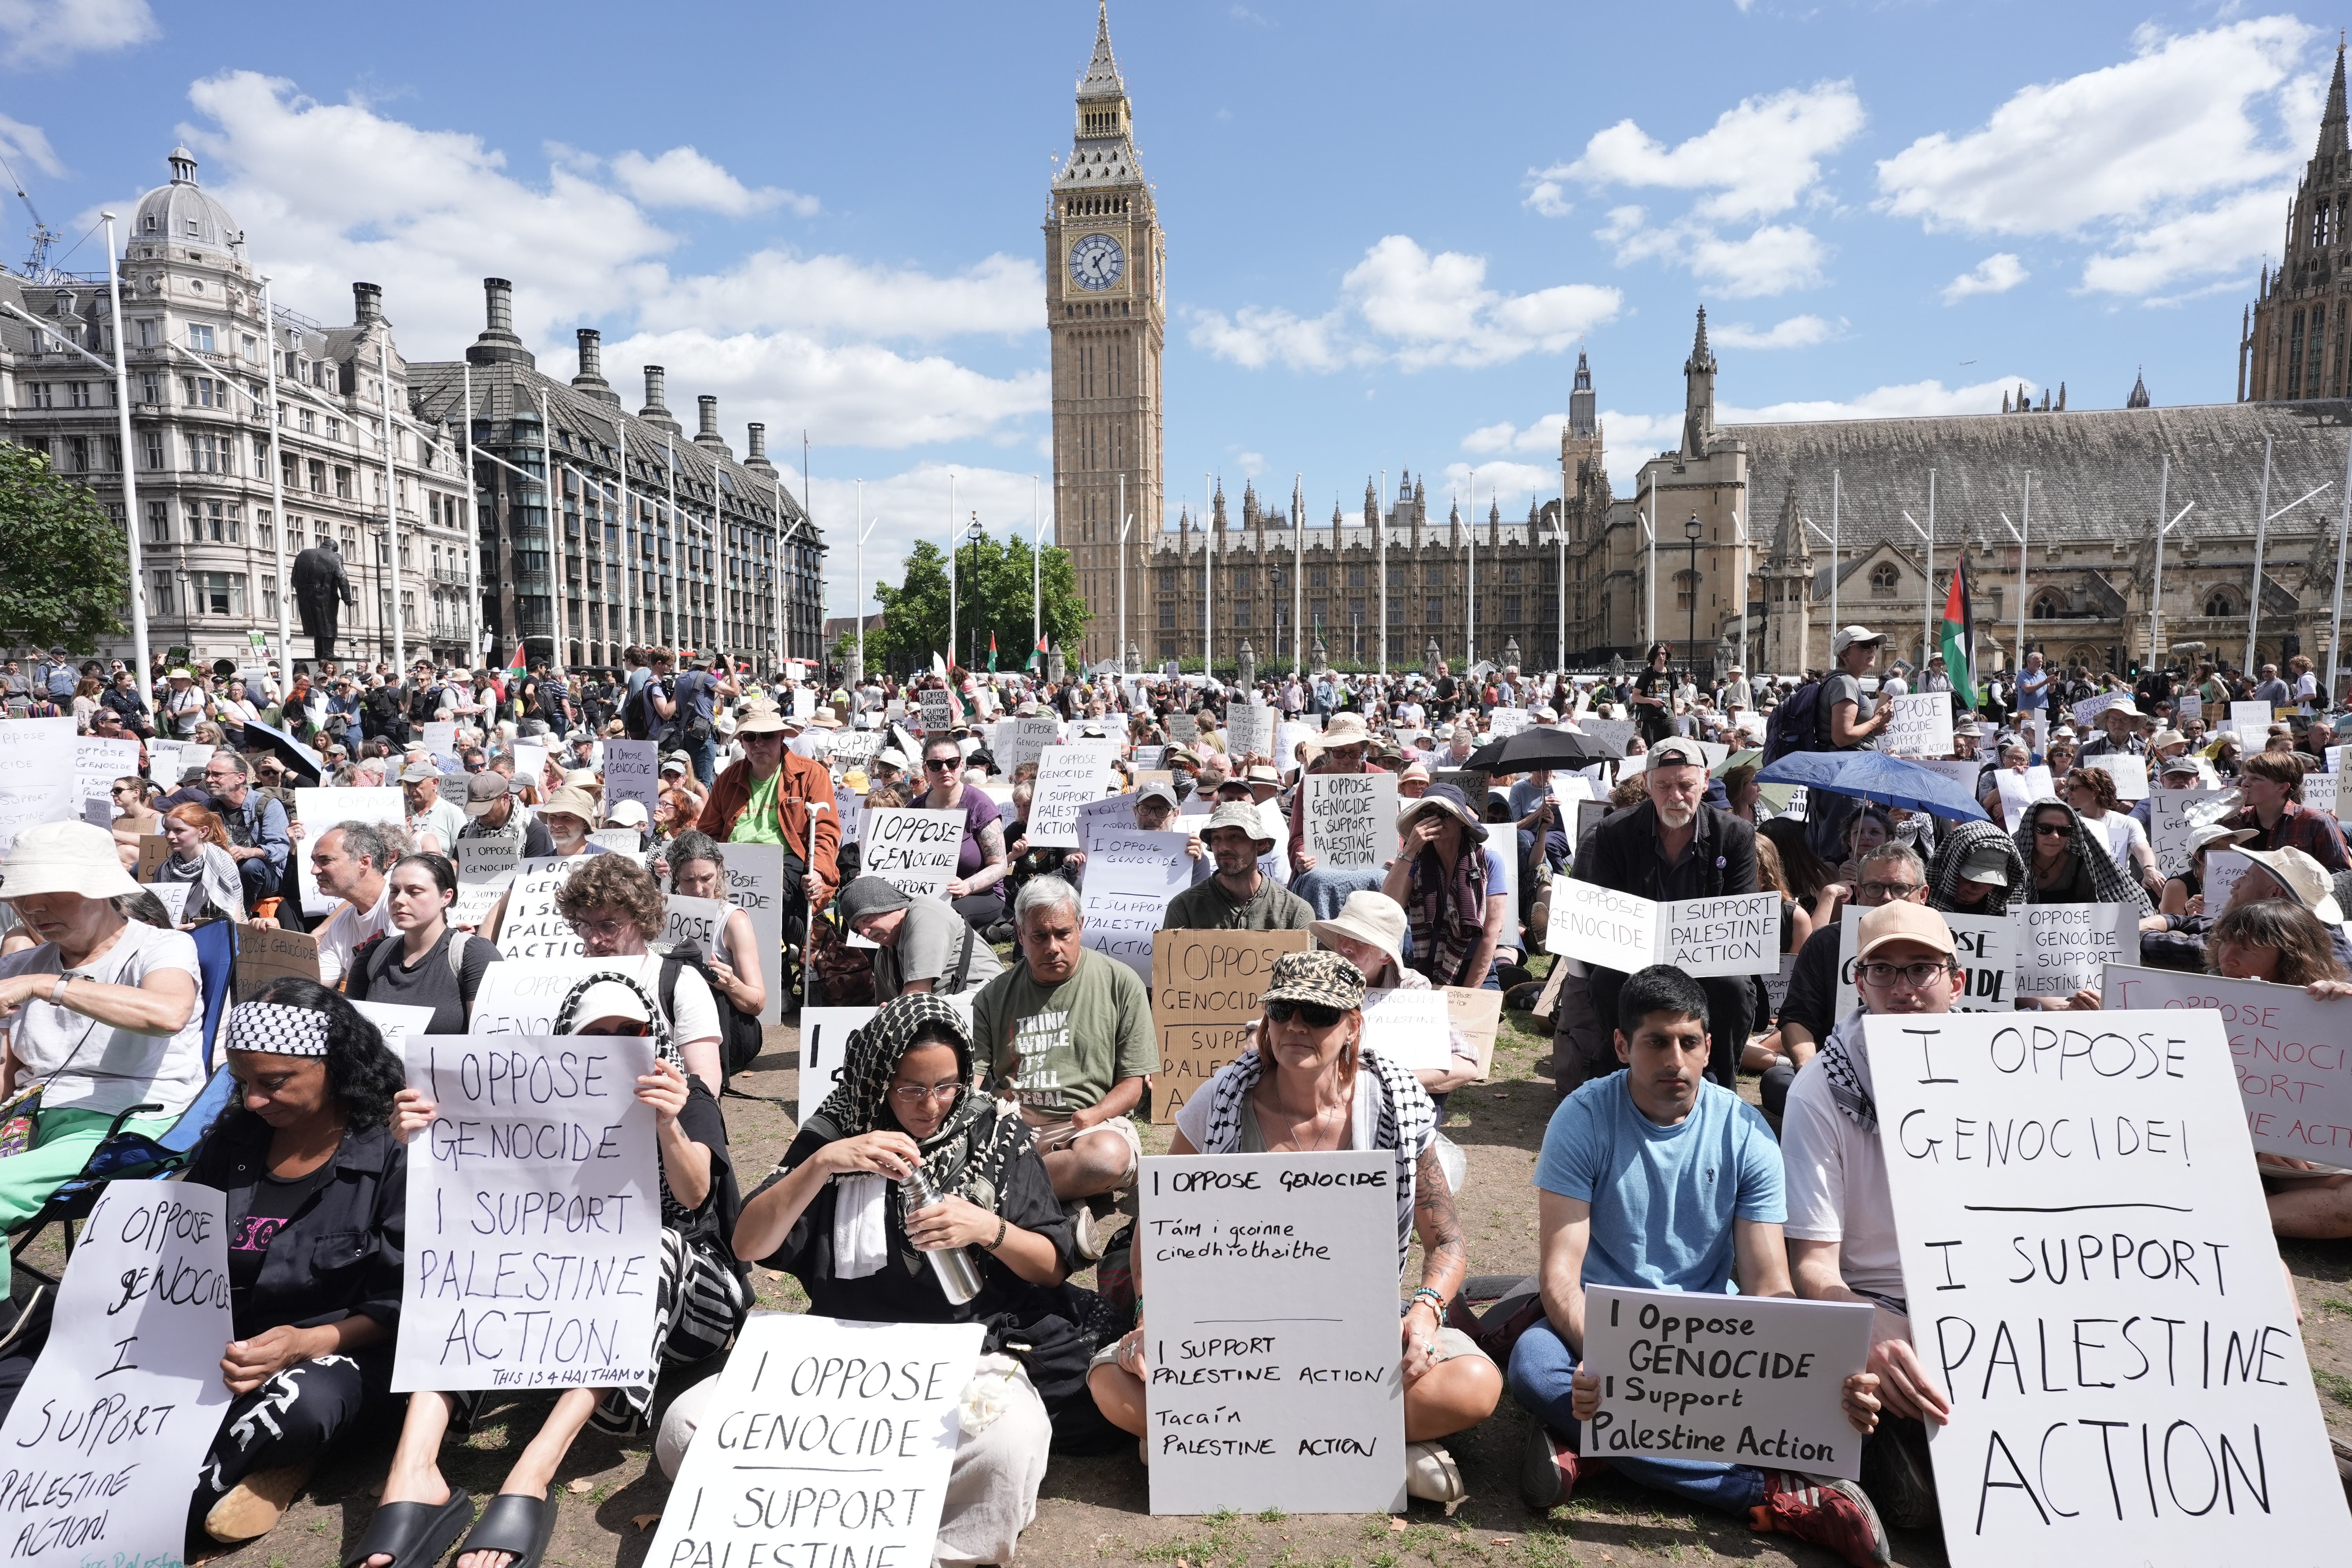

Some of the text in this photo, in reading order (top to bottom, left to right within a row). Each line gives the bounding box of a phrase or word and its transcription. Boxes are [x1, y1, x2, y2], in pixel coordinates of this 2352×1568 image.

[1016, 721, 1053, 734] I OPPOSE
[838, 735, 887, 751] OPPOSE
[1016, 737, 1053, 747] GENOCIDE
[1230, 742, 1268, 754] ACTION
[1884, 733, 1933, 747] SUPPORT
[1929, 743, 1953, 753] ACTION
[77, 748, 125, 757] OPPOSE
[610, 748, 612, 760] I
[1016, 751, 1020, 762] I
[1060, 755, 1097, 764] OPPOSE
[76, 757, 131, 770] GENOCIDE
[609, 763, 651, 775] GENOCIDE
[445, 779, 464, 788] Oppose
[1040, 770, 1094, 779] GENOCIDE
[1450, 776, 1487, 788] OPPOSE
[616, 789, 645, 799] SUPPORT
[1314, 777, 1374, 797] I OPPOSE
[0, 793, 49, 805] SUPPORT
[339, 796, 400, 808] OPPOSE
[1049, 791, 1096, 802] SUPPORT
[2154, 796, 2169, 813] I
[87, 811, 107, 820] GENOCIDE
[91, 803, 107, 811] OPPOSE
[1312, 797, 1375, 817] GENOCIDE
[873, 814, 964, 843] I OPPOSE
[1310, 818, 1375, 835] I SUPPORT
[592, 835, 639, 848] OPPOSE
[1093, 838, 1163, 852] I OPPOSE
[1314, 833, 1375, 853] PALESTINE
[2155, 837, 2173, 853] I
[151, 845, 154, 858] I
[466, 846, 515, 857] I OPPOSE
[867, 848, 955, 871] GENOCIDE
[1329, 849, 1375, 865] ACTION
[465, 863, 517, 873] GENOCIDE
[526, 864, 533, 876] I
[1107, 855, 1179, 867] GENOCIDE
[2216, 866, 2223, 875] I
[519, 906, 524, 917] I
[1088, 897, 1100, 909] I
[1577, 889, 1647, 920] OPPOSE
[1671, 895, 1779, 923] I SUPPORT
[2029, 911, 2090, 925] OPPOSE
[1549, 907, 1647, 950] GENOCIDE
[1671, 918, 1777, 946] PALESTINE
[506, 942, 585, 958] ACTIO
[1095, 936, 1152, 955] ACTIO
[1674, 942, 1761, 965] ACTION
[1167, 942, 1172, 984] I
[2038, 952, 2122, 967] SUPPORT
[1368, 991, 1439, 1005] GENOCIDE
[1016, 1010, 1069, 1034] THINK
[1368, 1014, 1439, 1024] PALESTINE
[810, 1024, 820, 1068] I
[1016, 1029, 1069, 1053] WHILE
[1164, 1031, 1169, 1052] I
[1018, 1054, 1047, 1073] IT'S
[1902, 1026, 2187, 1084] I OPPOSE
[430, 1047, 608, 1106] I OPPOSE
[1013, 1071, 1060, 1089] STILL
[1011, 1090, 1067, 1107] LEGAL
[431, 1117, 622, 1171] GENOCIDE
[1900, 1108, 2192, 1168] GENOCIDE!
[1154, 1171, 1388, 1196] I OPPOSE GENOCIDE
[437, 1187, 632, 1235] I SUPPORT
[79, 1196, 214, 1254] I OPPOSE
[1924, 1233, 2230, 1296] I SUPPORT
[420, 1249, 645, 1301] PALESTINE
[1611, 1299, 1755, 1343] I Oppose
[440, 1308, 620, 1366] ACTION.
[95, 1336, 139, 1380] I
[1158, 1337, 1276, 1365] I SUPPORT
[1629, 1339, 1816, 1379] GENOCIDE
[1936, 1316, 2293, 1405] PALESTINE
[493, 1368, 521, 1386] THIS
[751, 1350, 951, 1401] I OPPOSE
[1152, 1367, 1385, 1385] PALESTINE ACTION
[1606, 1376, 1743, 1416] I Support
[16, 1392, 176, 1457] SUPPORT
[717, 1411, 921, 1457] GENOCIDE
[1592, 1411, 1835, 1463] Palestine Action
[1163, 1434, 1377, 1457] PALESTINE ACTION
[1975, 1418, 2272, 1537] ACTION
[688, 1486, 926, 1532] I SUPPORT
[11, 1508, 108, 1559] ACTION.
